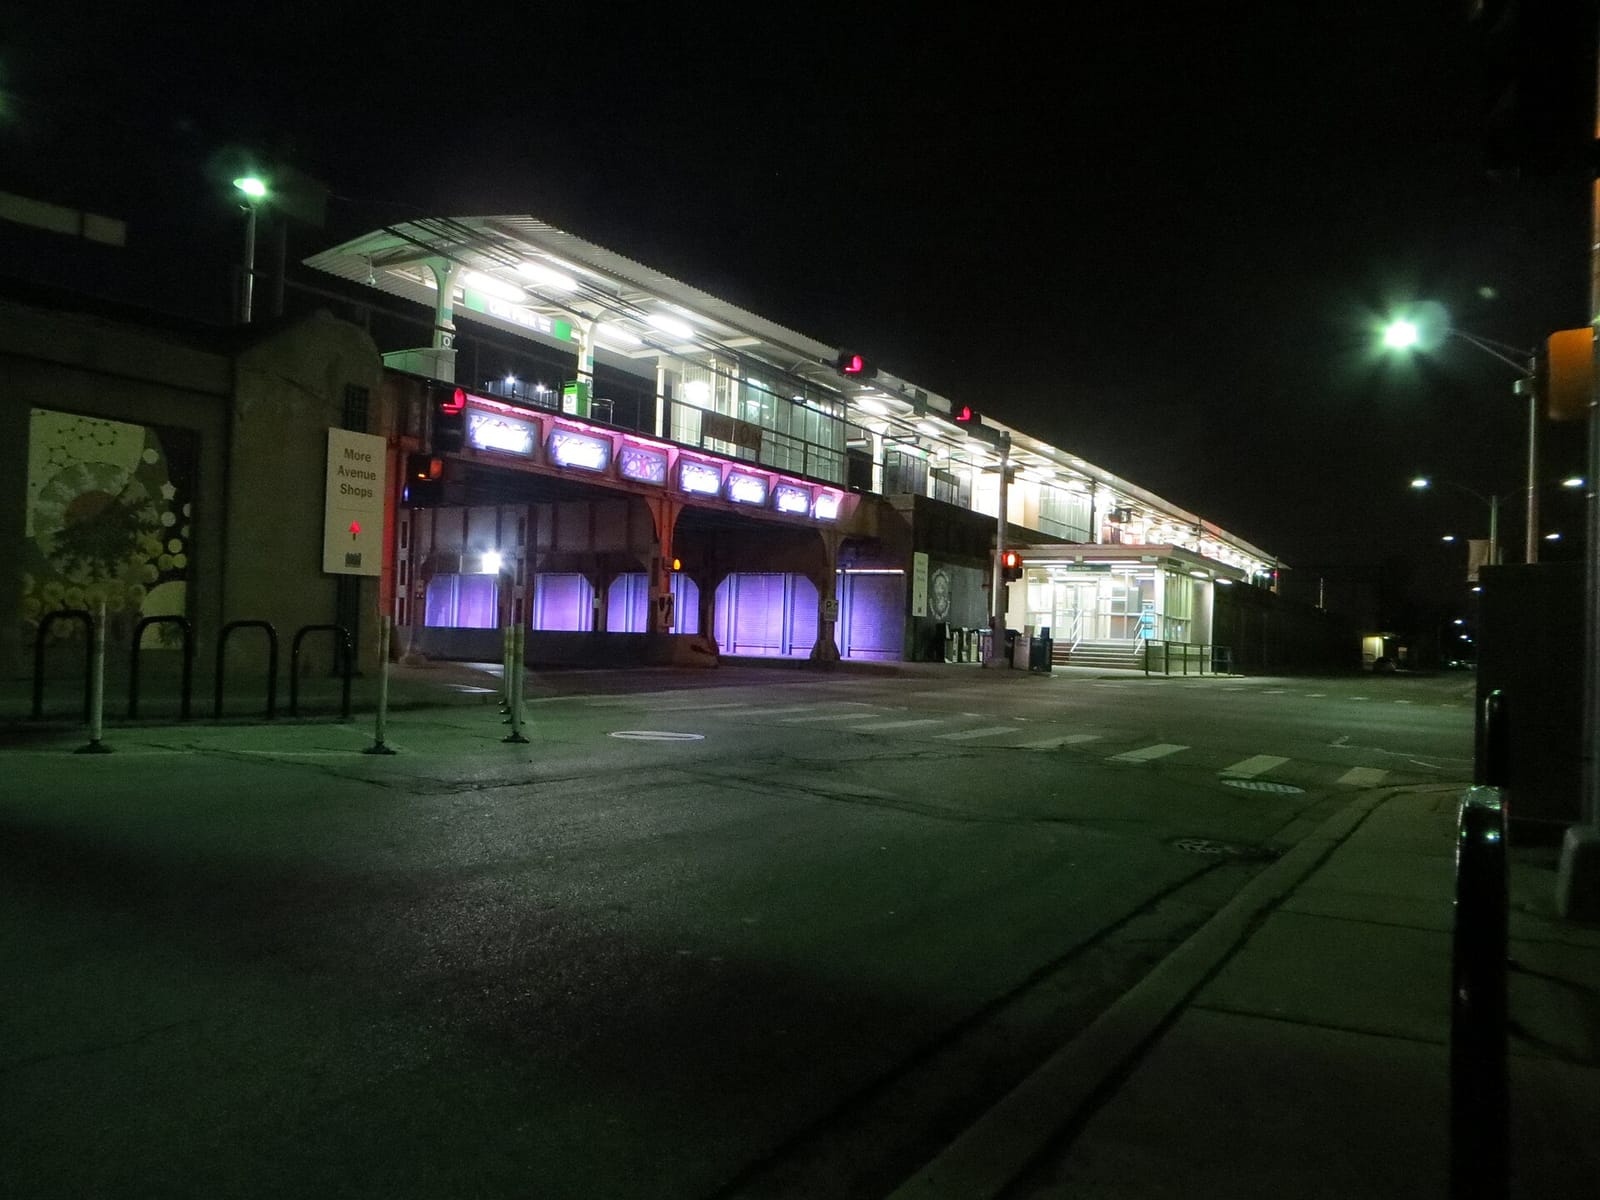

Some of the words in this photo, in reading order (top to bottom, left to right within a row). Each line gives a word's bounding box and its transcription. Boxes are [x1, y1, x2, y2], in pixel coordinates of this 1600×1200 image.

[344, 448, 371, 462] More
[338, 465, 376, 480] Avenue
[340, 483, 373, 498] Shops
